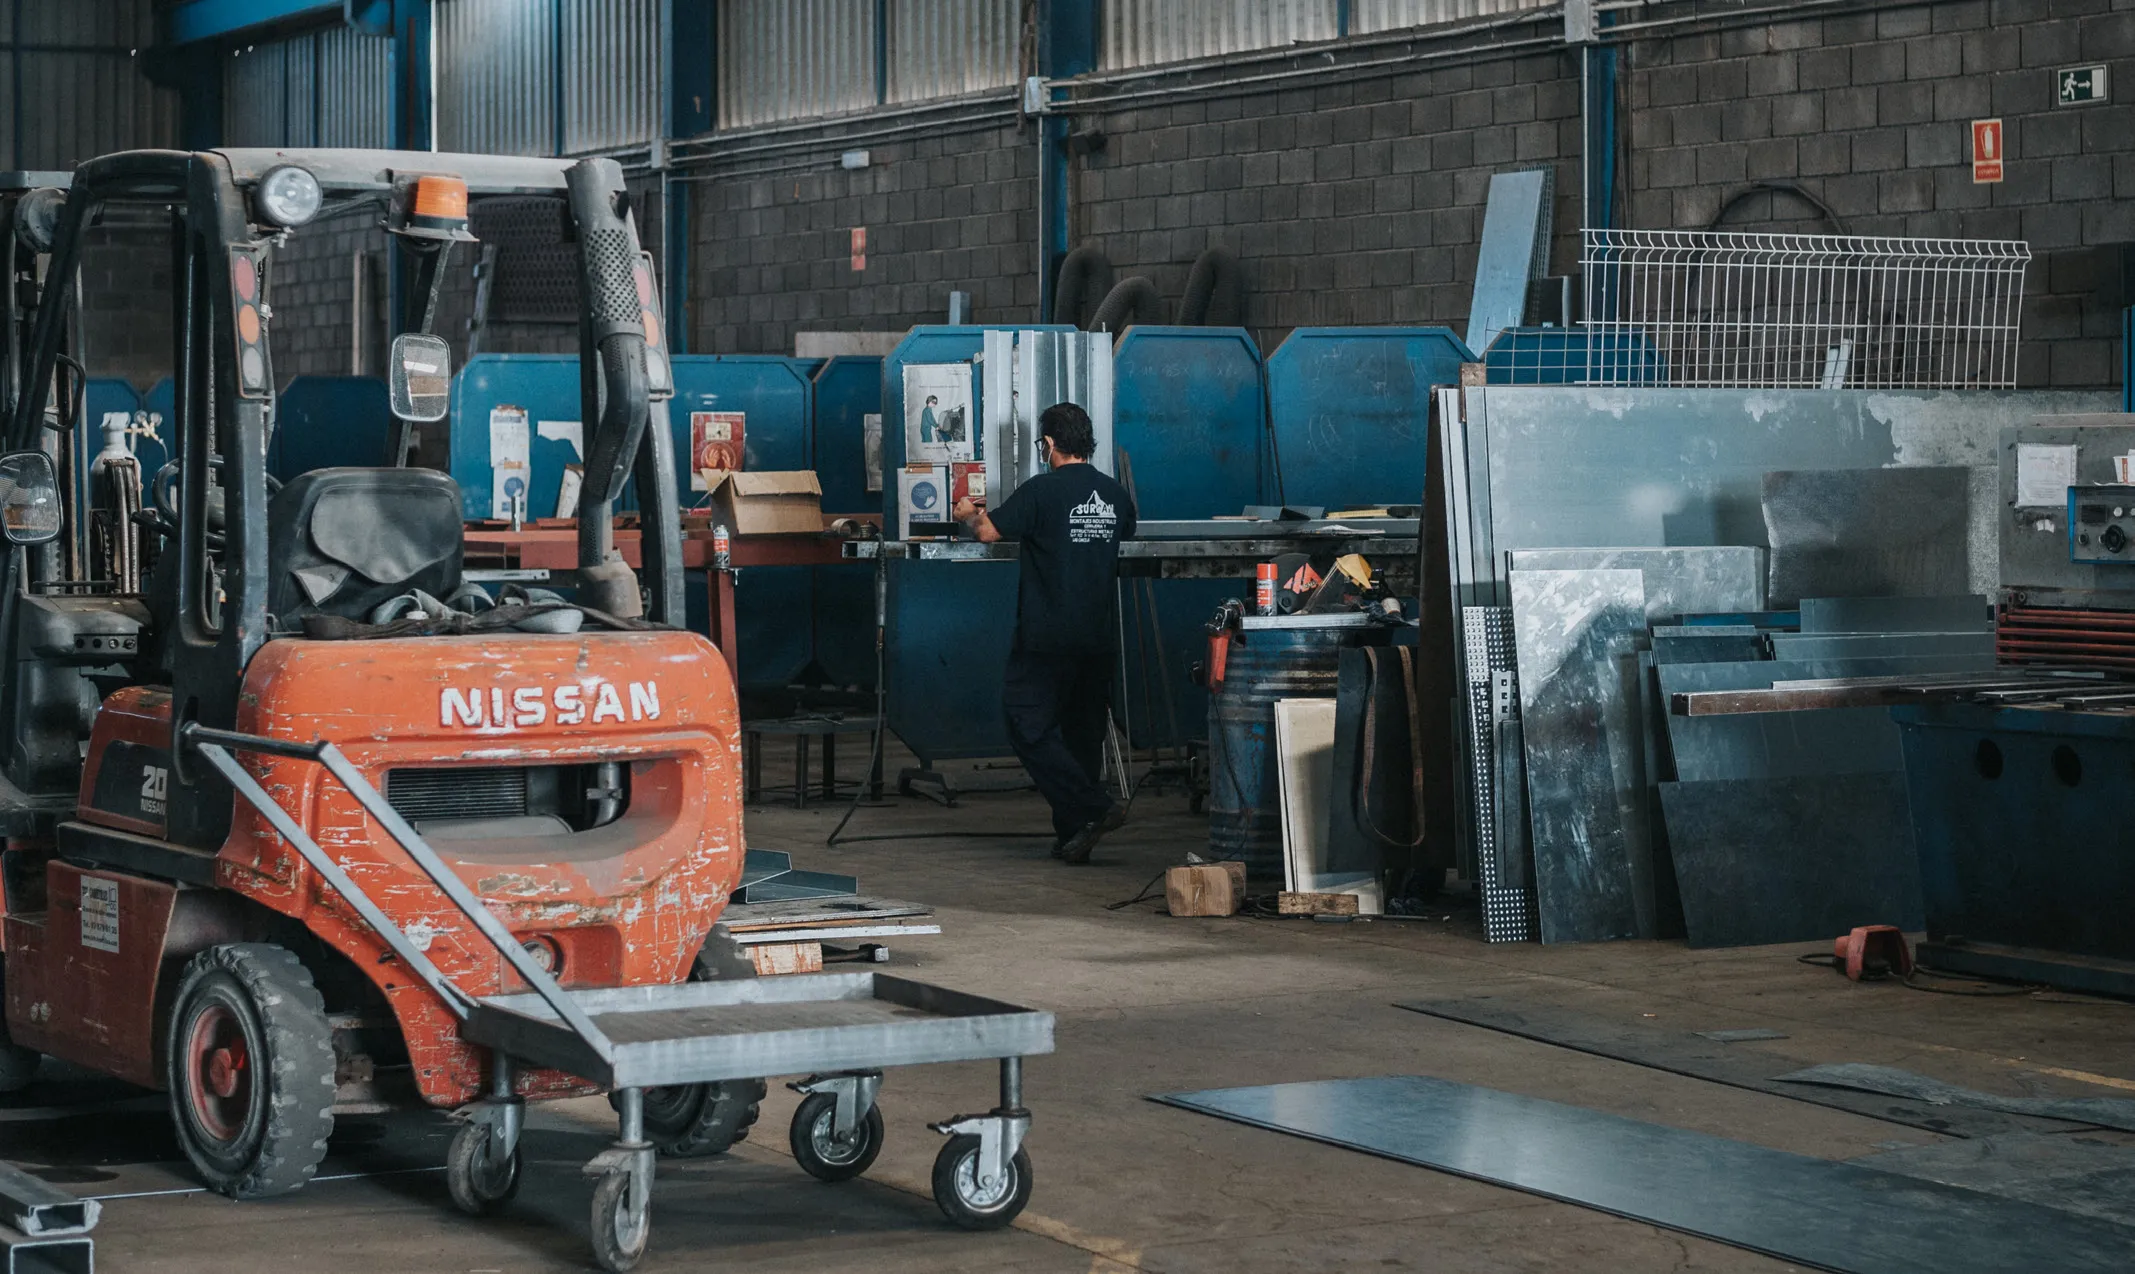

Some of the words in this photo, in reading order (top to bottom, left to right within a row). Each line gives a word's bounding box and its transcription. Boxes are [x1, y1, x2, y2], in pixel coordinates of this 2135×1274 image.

[440, 681, 660, 726] NISSAN
[142, 765, 168, 800] 20
[140, 798, 167, 816] NISSAN
